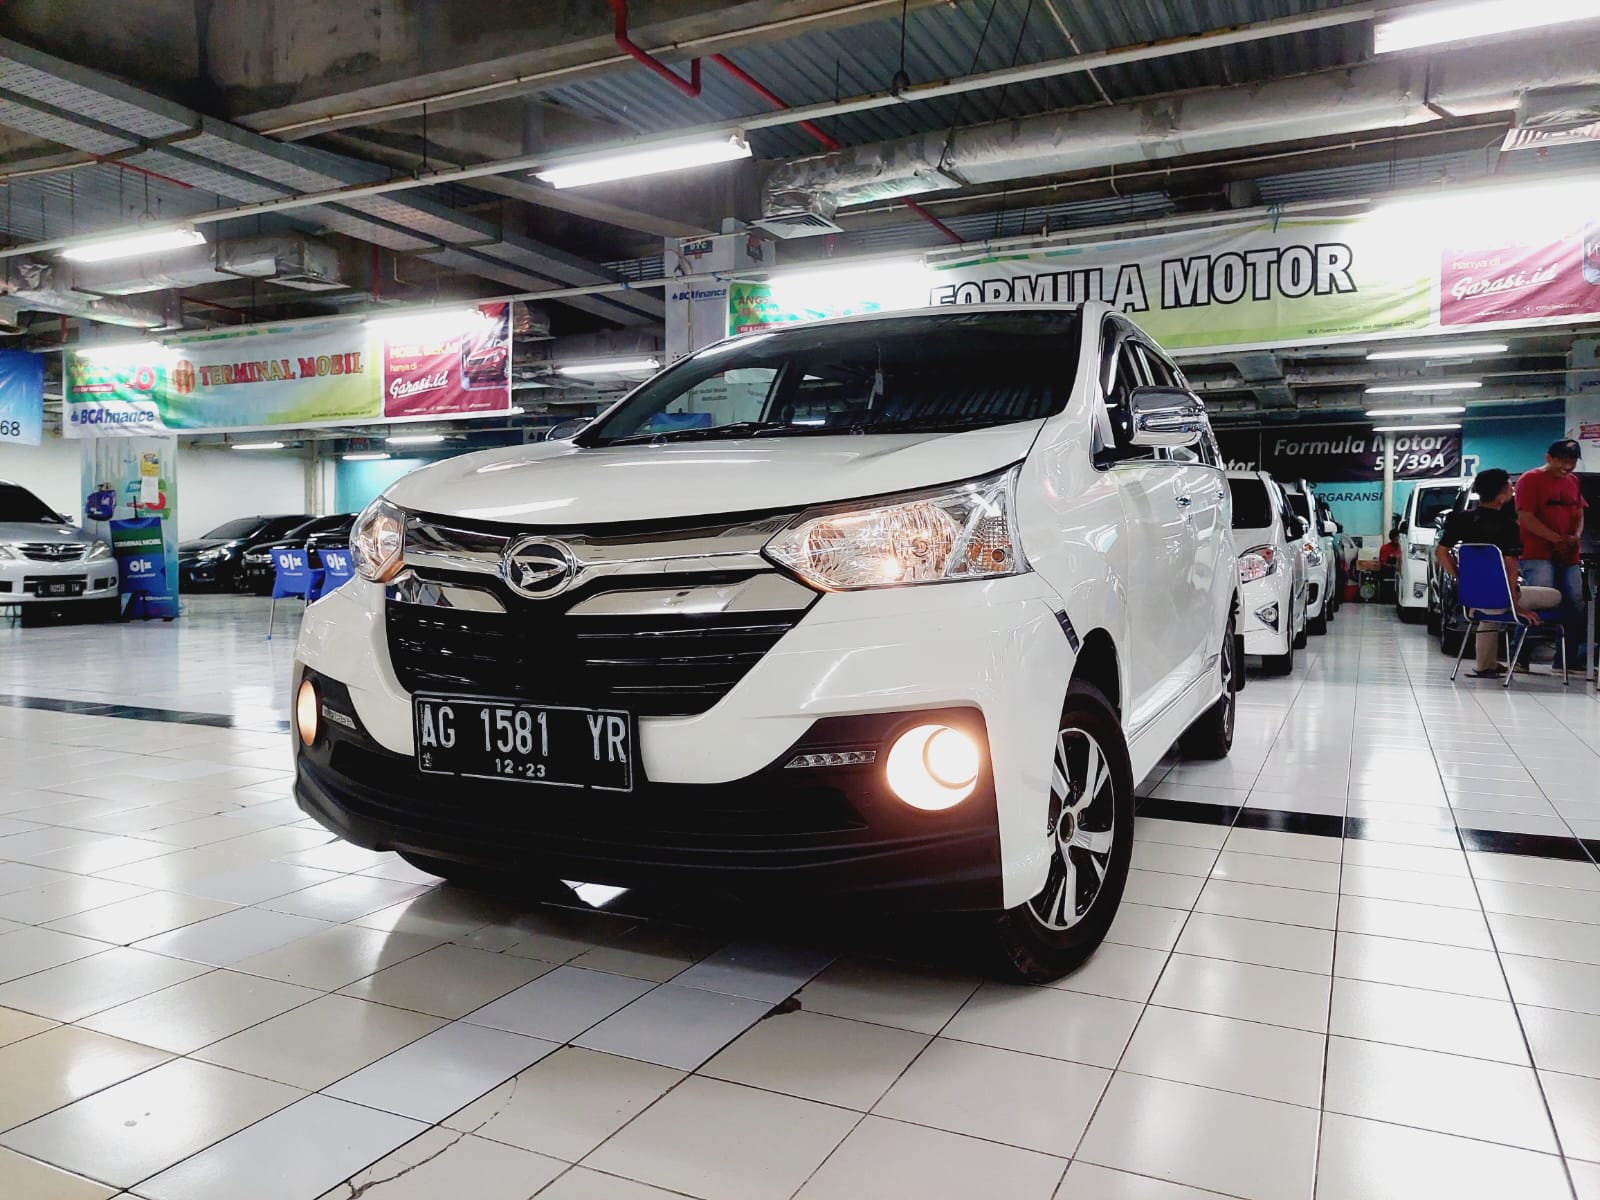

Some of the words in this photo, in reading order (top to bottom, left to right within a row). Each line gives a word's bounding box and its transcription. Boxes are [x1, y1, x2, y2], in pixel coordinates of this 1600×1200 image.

[1161, 242, 1357, 310] MOTOR
[1450, 263, 1560, 301] Garasi.id
[199, 358, 297, 387] TERMINAL
[298, 352, 365, 380] MOBIL
[0, 420, 21, 437] 68
[1274, 434, 1365, 457] Formula
[1372, 432, 1448, 454] Motor
[1314, 491, 1385, 503] RGARANSI
[421, 703, 456, 749] AG
[480, 707, 549, 757] 1581
[586, 714, 627, 763] YR
